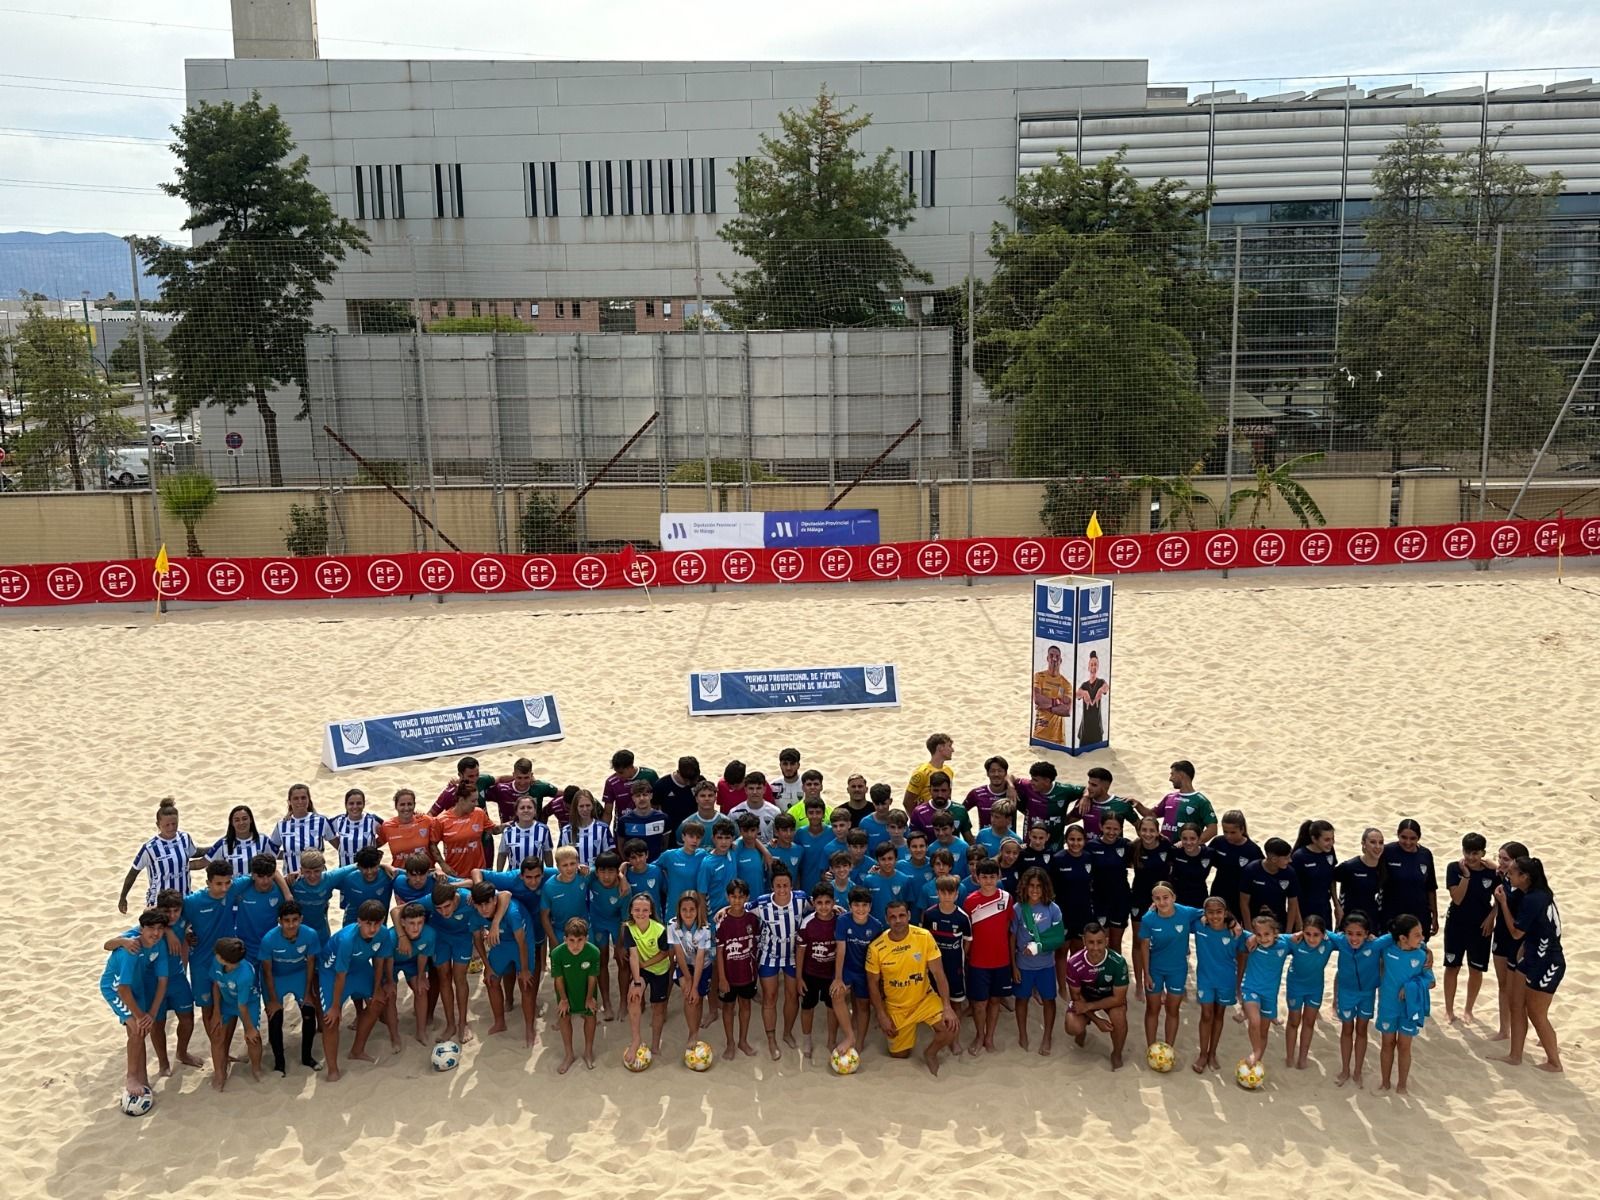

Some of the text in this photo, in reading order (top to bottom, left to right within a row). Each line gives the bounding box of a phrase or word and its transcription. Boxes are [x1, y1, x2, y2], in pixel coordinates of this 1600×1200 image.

[810, 672, 819, 680] DE
[807, 681, 816, 690] DE
[817, 680, 840, 689] MÁLAGA
[393, 718, 418, 729] TORNEO
[420, 713, 464, 725] PROMOCIONAL
[466, 710, 476, 719] DE
[424, 722, 462, 735] DIPUTACIÓN
[464, 720, 474, 730] DE
[476, 717, 500, 728] MÁLAGA
